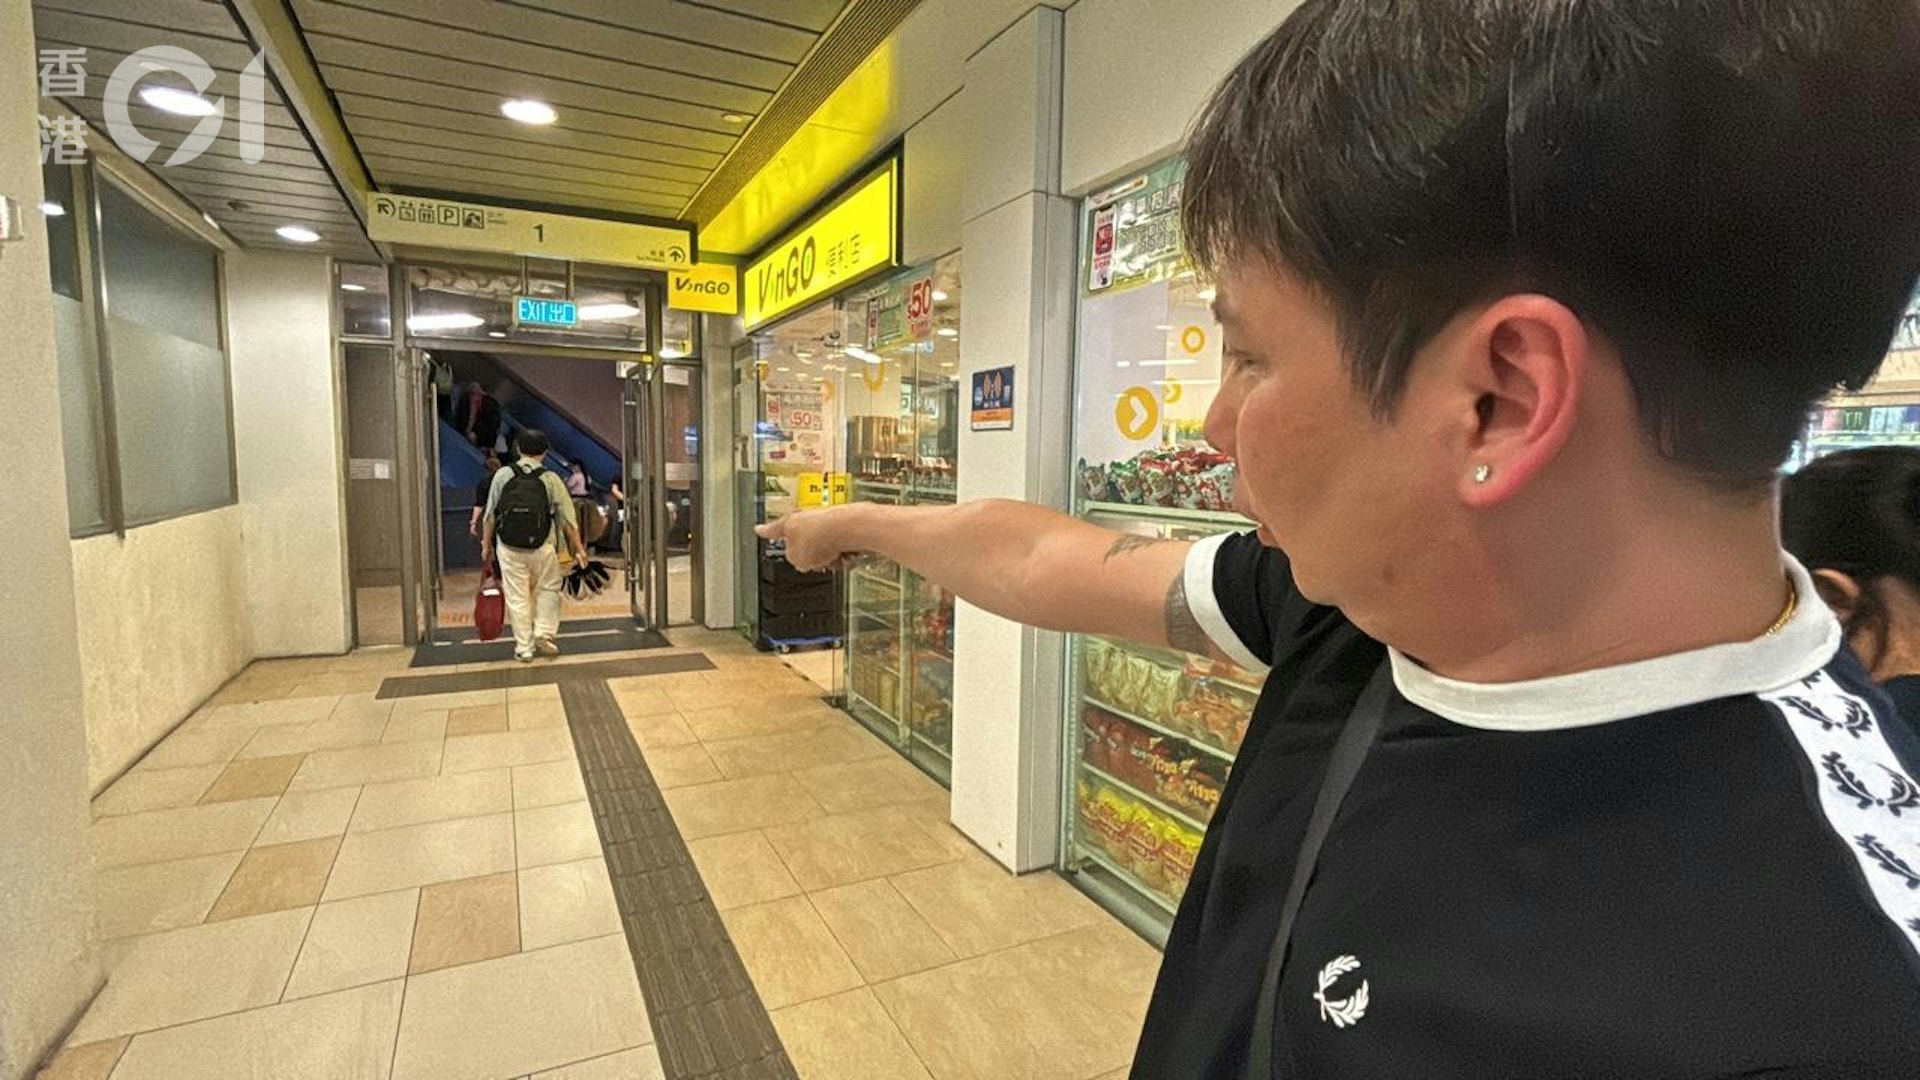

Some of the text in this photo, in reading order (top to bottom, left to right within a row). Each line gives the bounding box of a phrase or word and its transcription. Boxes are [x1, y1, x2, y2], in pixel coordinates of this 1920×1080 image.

[533, 224, 543, 242] 1
[519, 299, 577, 324] EXIT 出口
